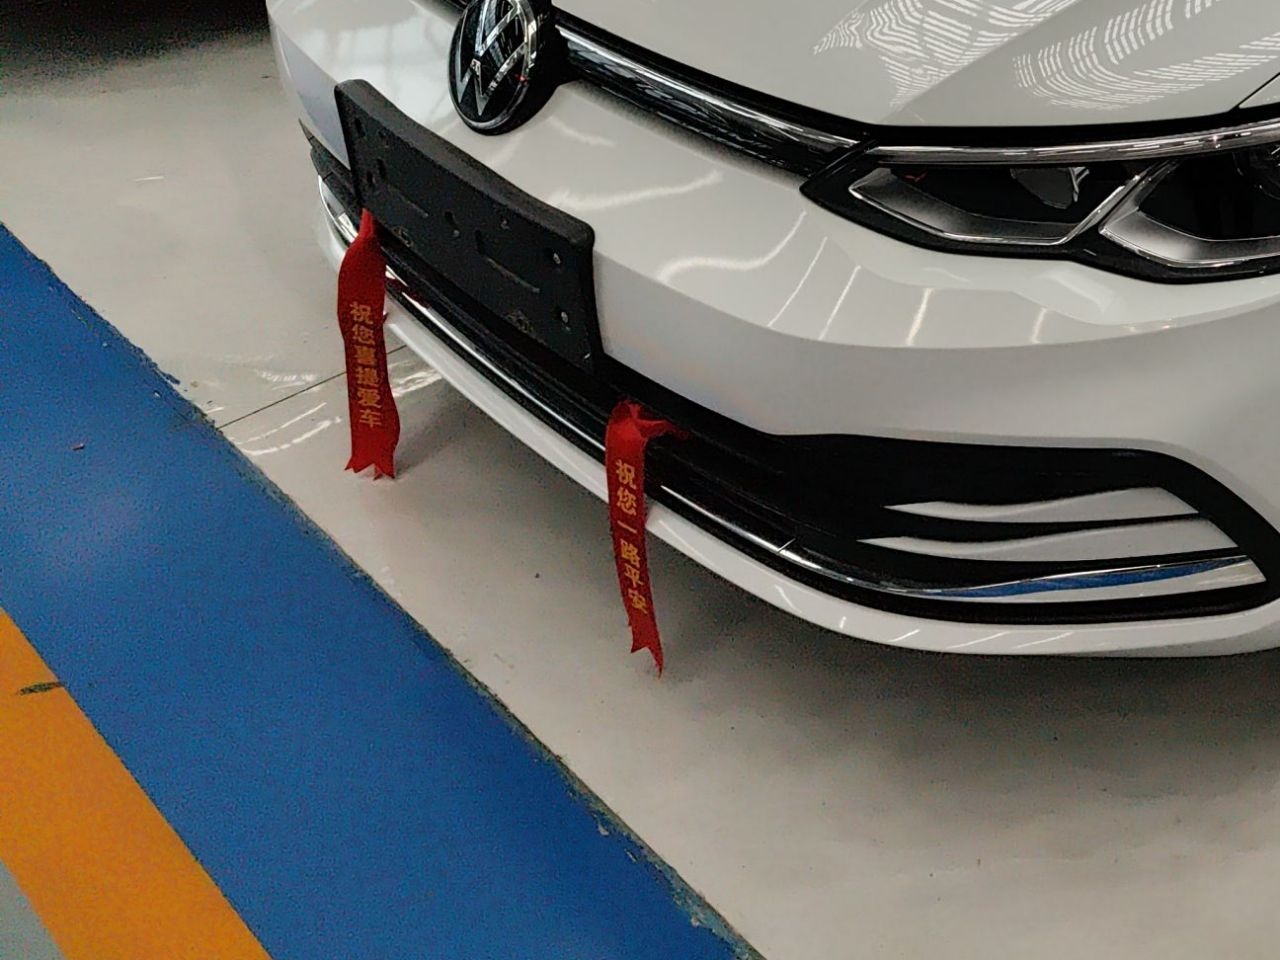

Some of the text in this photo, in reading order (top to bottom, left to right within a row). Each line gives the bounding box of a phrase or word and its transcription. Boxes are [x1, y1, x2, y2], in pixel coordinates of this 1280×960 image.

[349, 301, 382, 428] 祝您喜提爱车
[615, 458, 648, 615] 祝您一路平安
